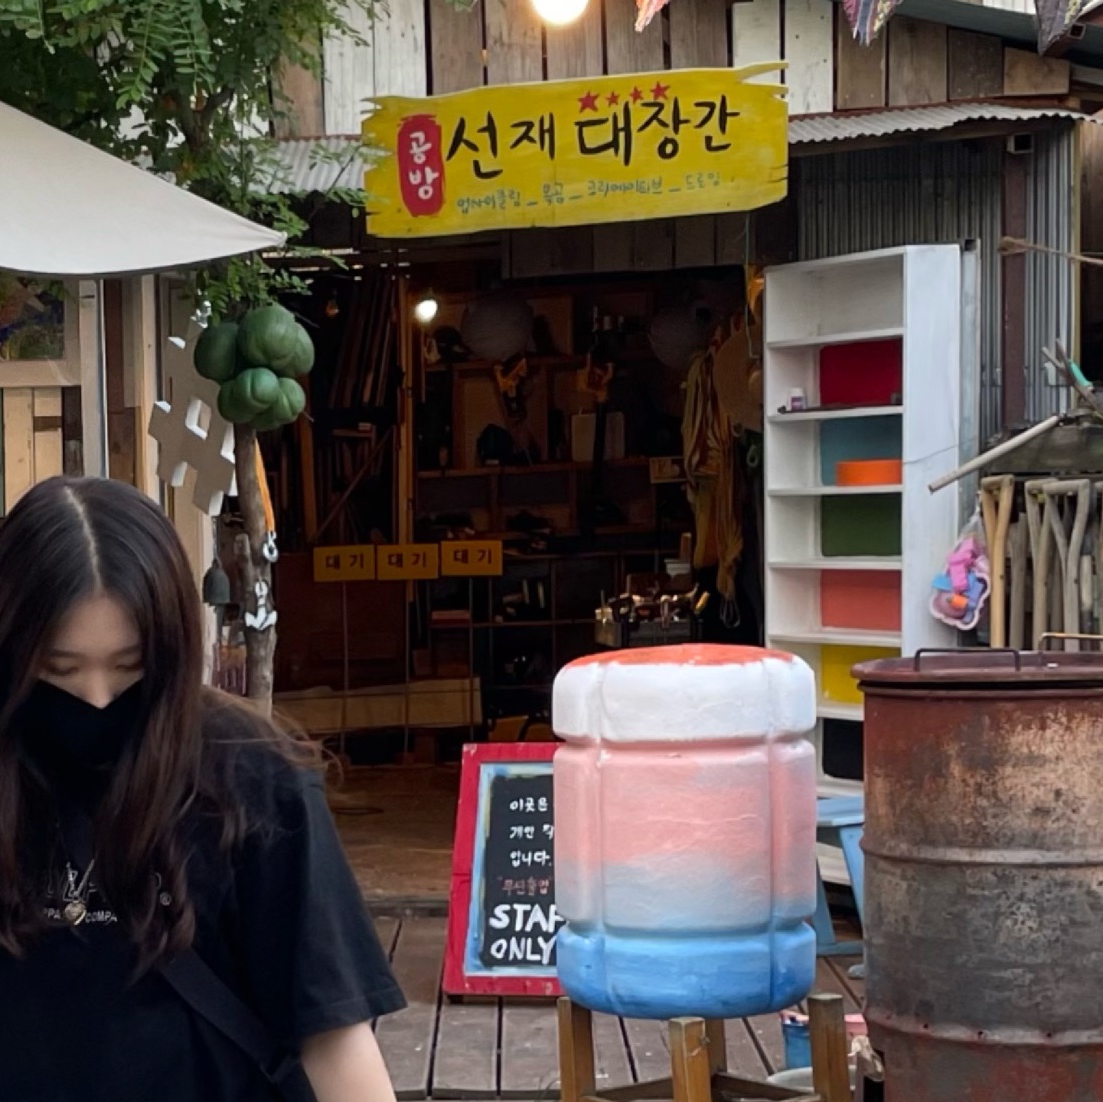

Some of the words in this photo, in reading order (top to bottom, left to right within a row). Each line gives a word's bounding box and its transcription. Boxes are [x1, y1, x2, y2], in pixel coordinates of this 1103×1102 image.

[446, 111, 557, 180] 선재
[574, 95, 741, 168] 대장간
[408, 130, 440, 201] 공방
[457, 188, 521, 214] 업사이클링
[542, 182, 565, 206] 목공
[588, 176, 663, 197] 크리에이티브
[686, 171, 720, 190] 드로잉
[325, 553, 364, 570] 대기
[387, 552, 426, 568] 대기
[452, 548, 493, 566] 대기
[509, 824, 535, 840] 개인
[509, 850, 553, 868] 입니다.
[490, 936, 557, 965] ONLY
